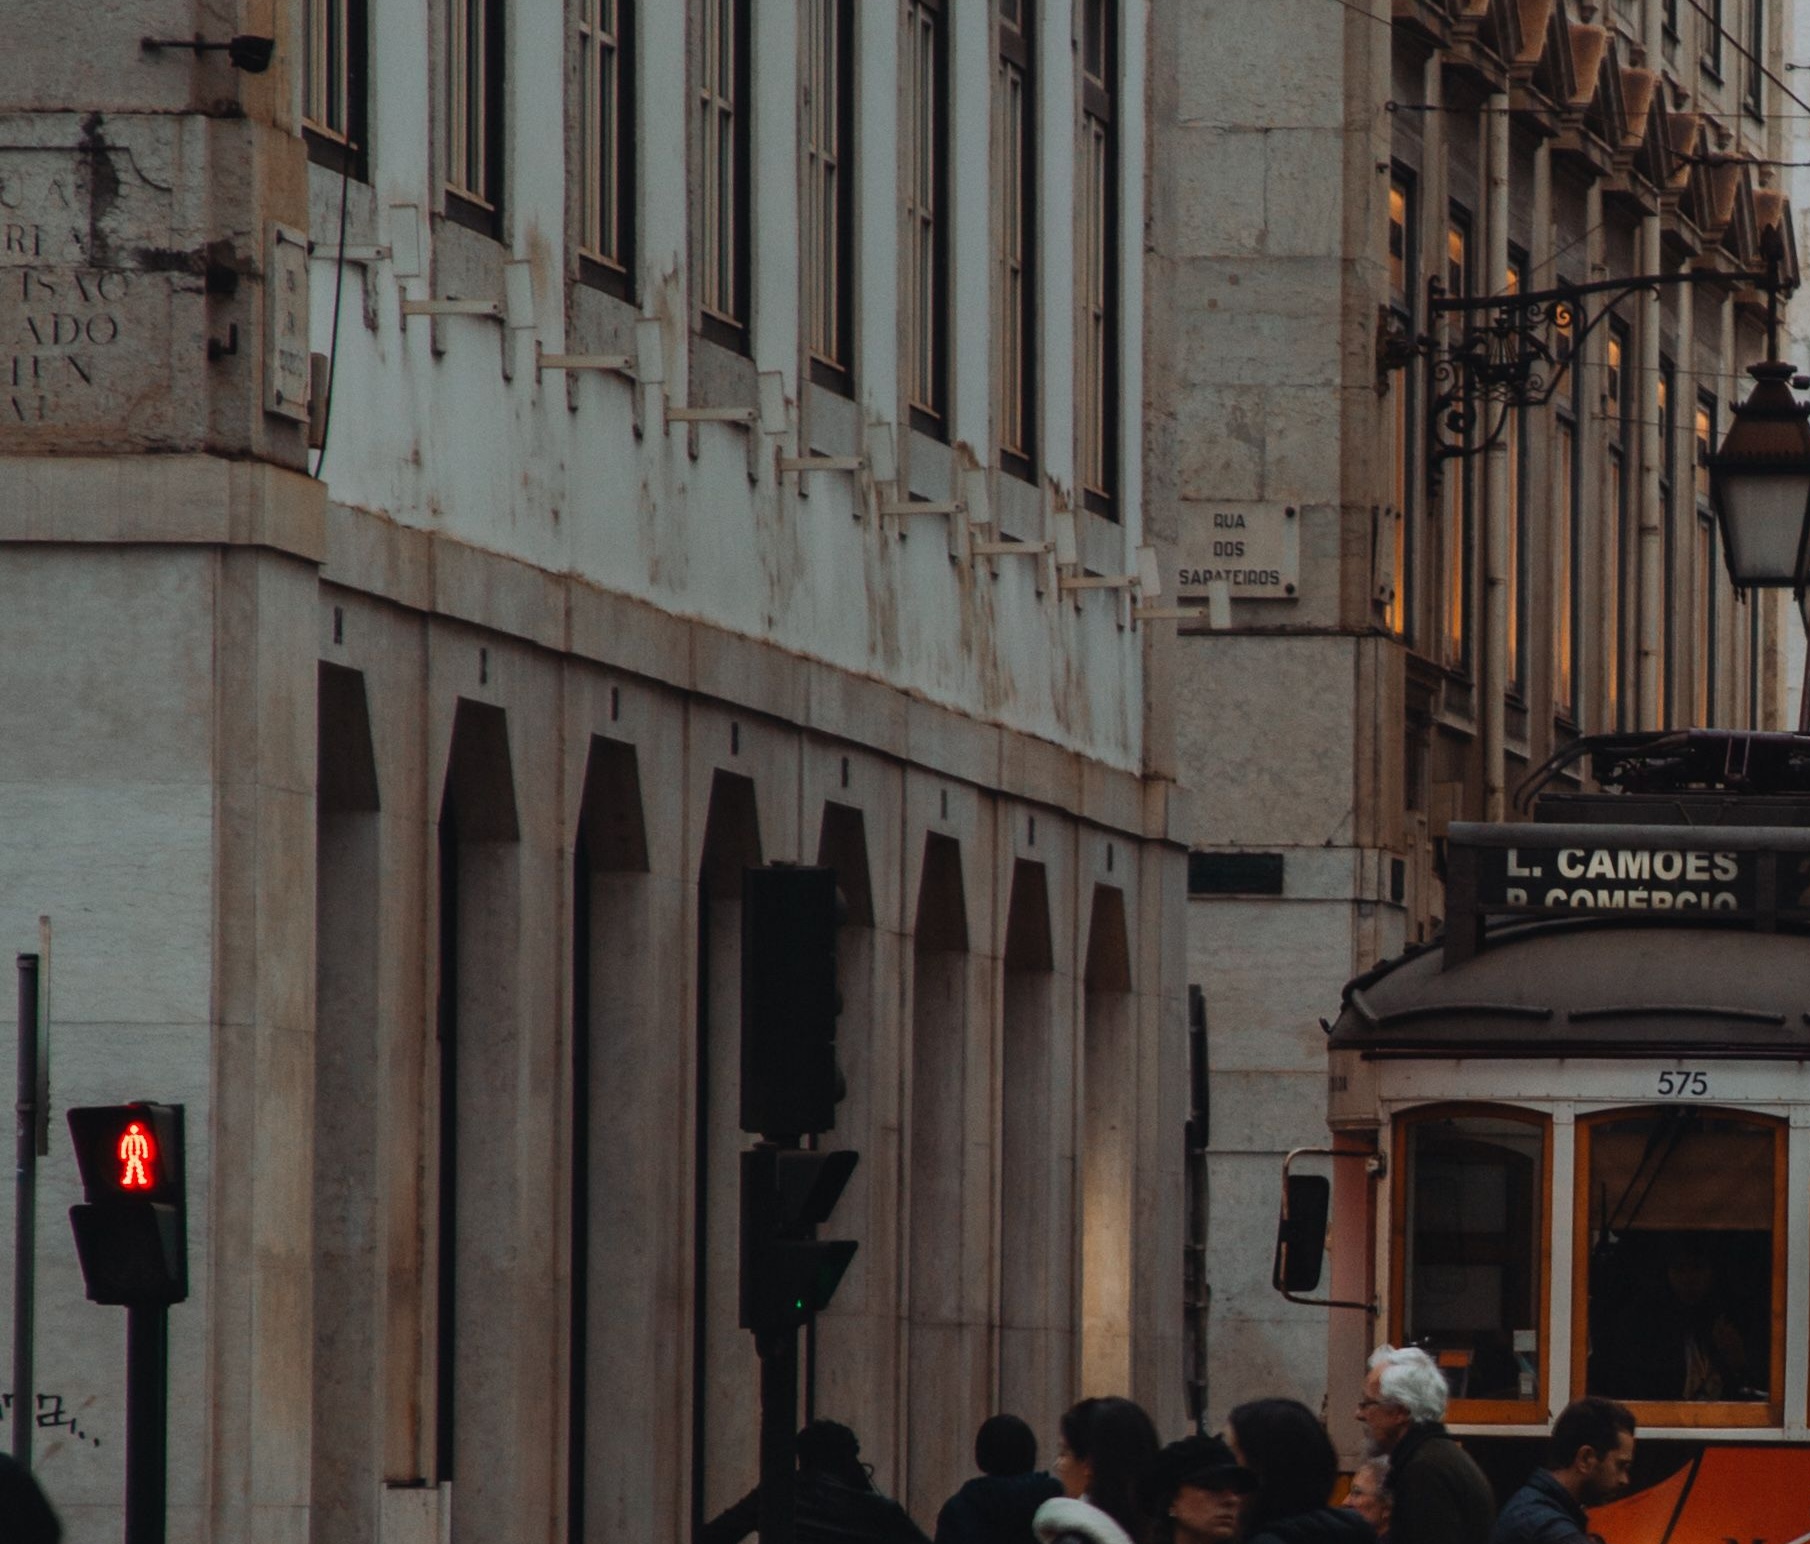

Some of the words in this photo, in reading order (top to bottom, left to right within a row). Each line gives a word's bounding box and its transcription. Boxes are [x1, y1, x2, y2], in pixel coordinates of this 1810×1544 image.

[1213, 513, 1246, 529] RUA
[1213, 541, 1245, 557] DOS
[1179, 569, 1280, 586] SAPATEIROS
[1507, 848, 1542, 878] L.
[1657, 1071, 1708, 1096] 575
